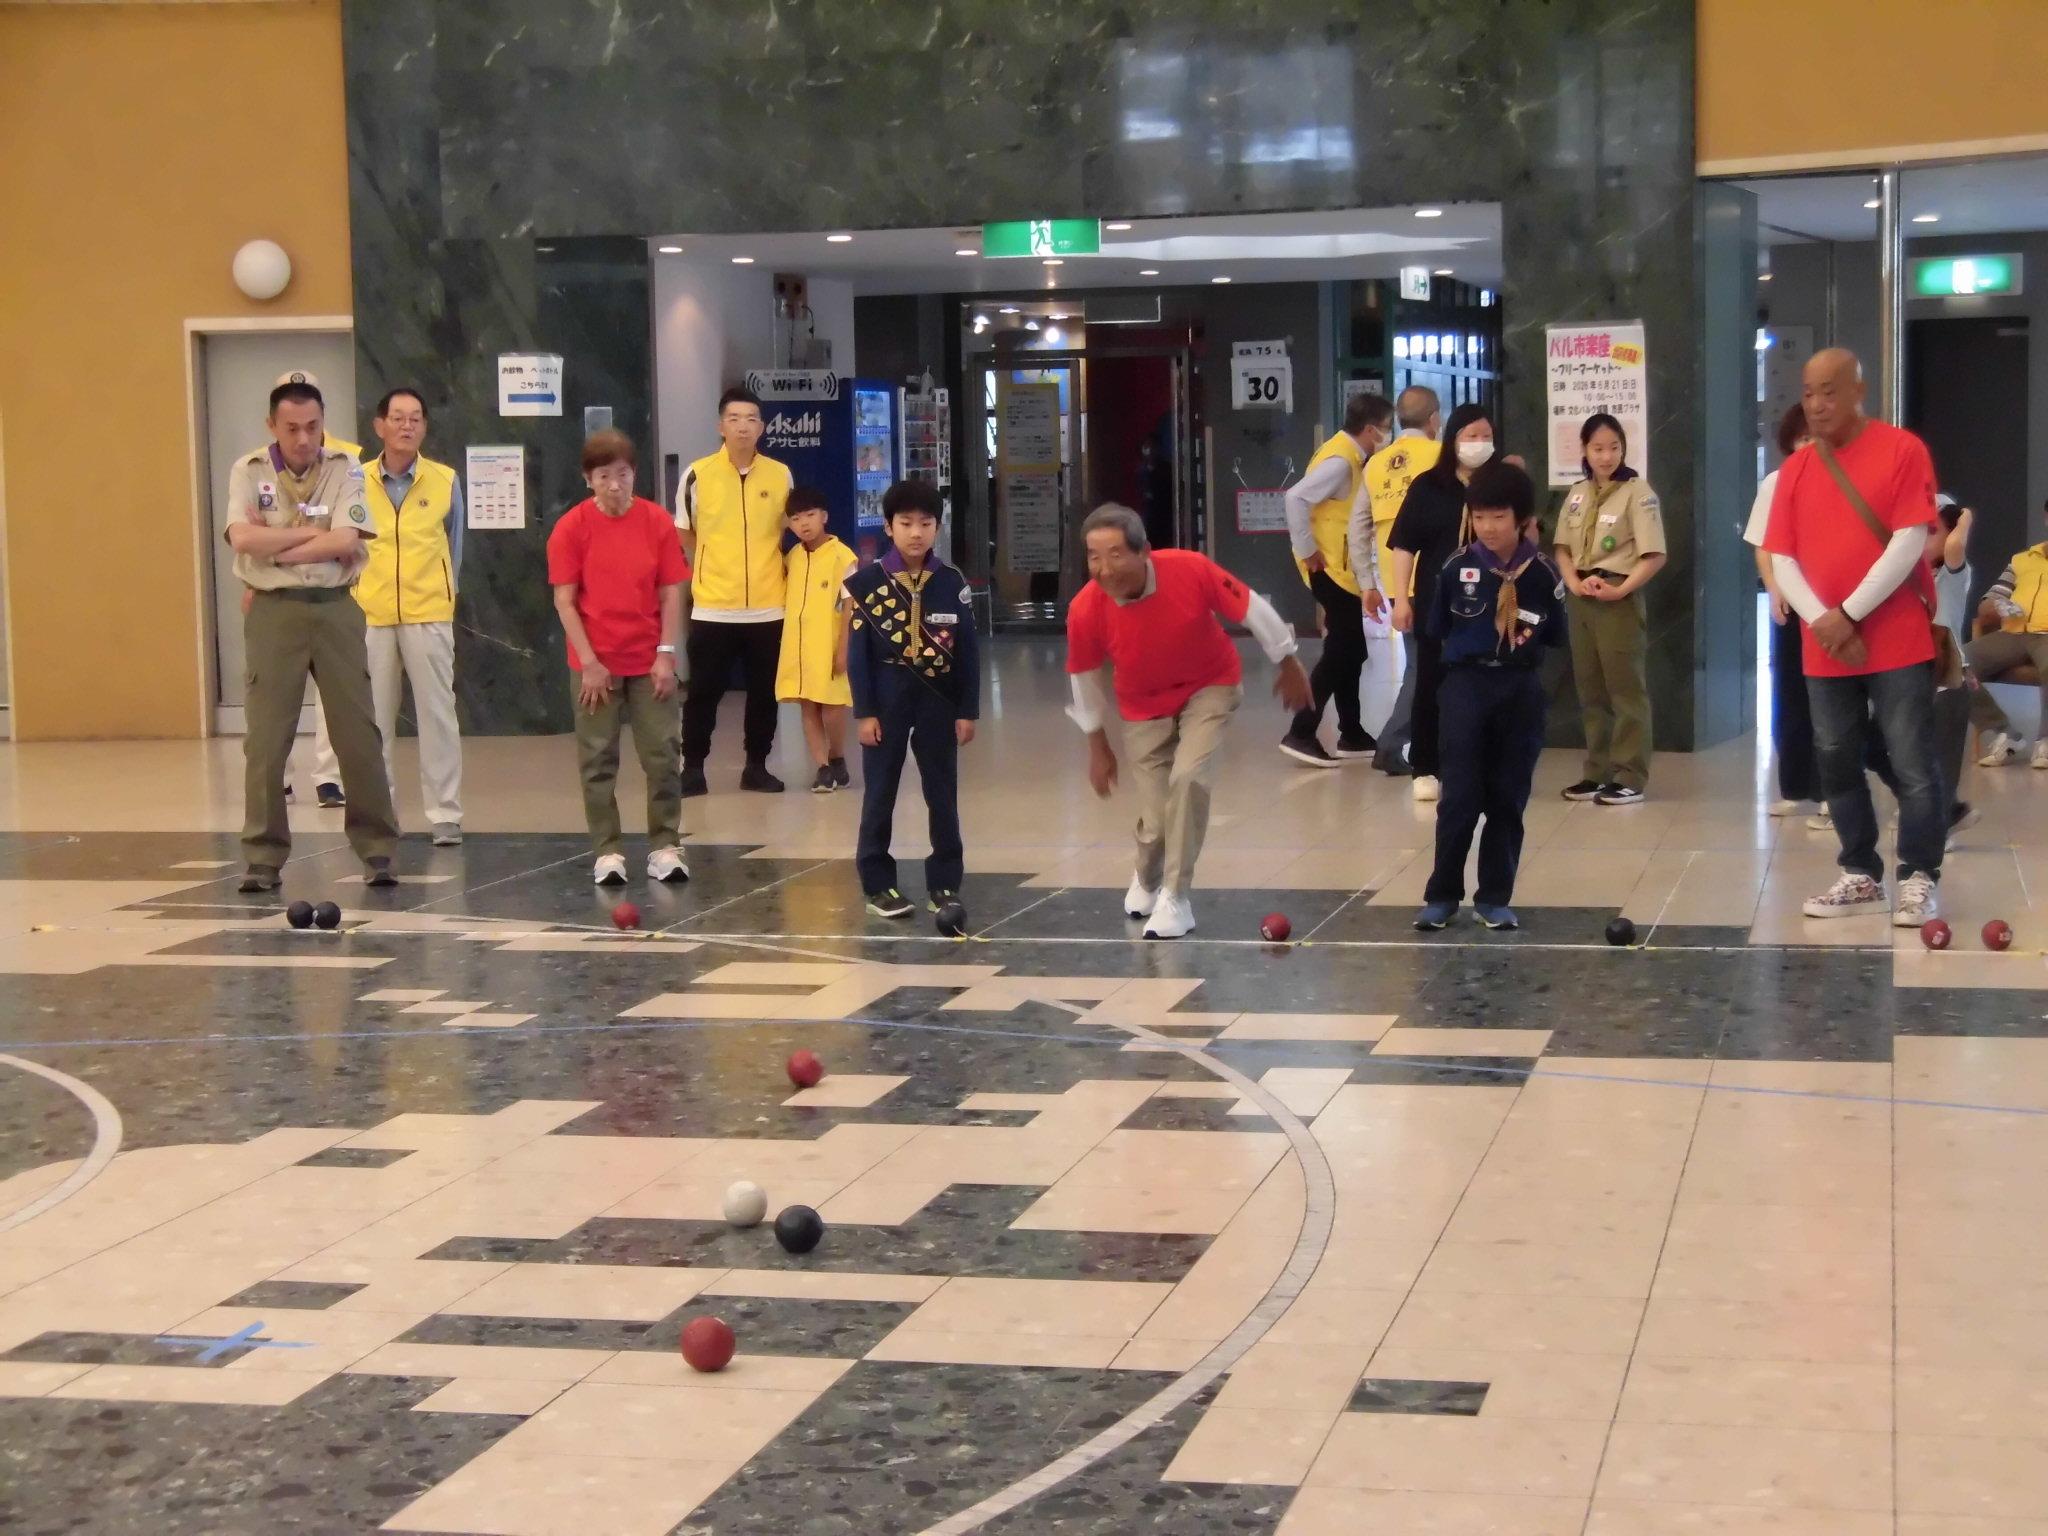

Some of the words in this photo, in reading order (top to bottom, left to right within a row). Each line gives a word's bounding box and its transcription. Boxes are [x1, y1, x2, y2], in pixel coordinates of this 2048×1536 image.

[1248, 376, 1279, 401] 30
[766, 411, 821, 435] Asahi
[766, 436, 821, 448] アサヒ飲料
